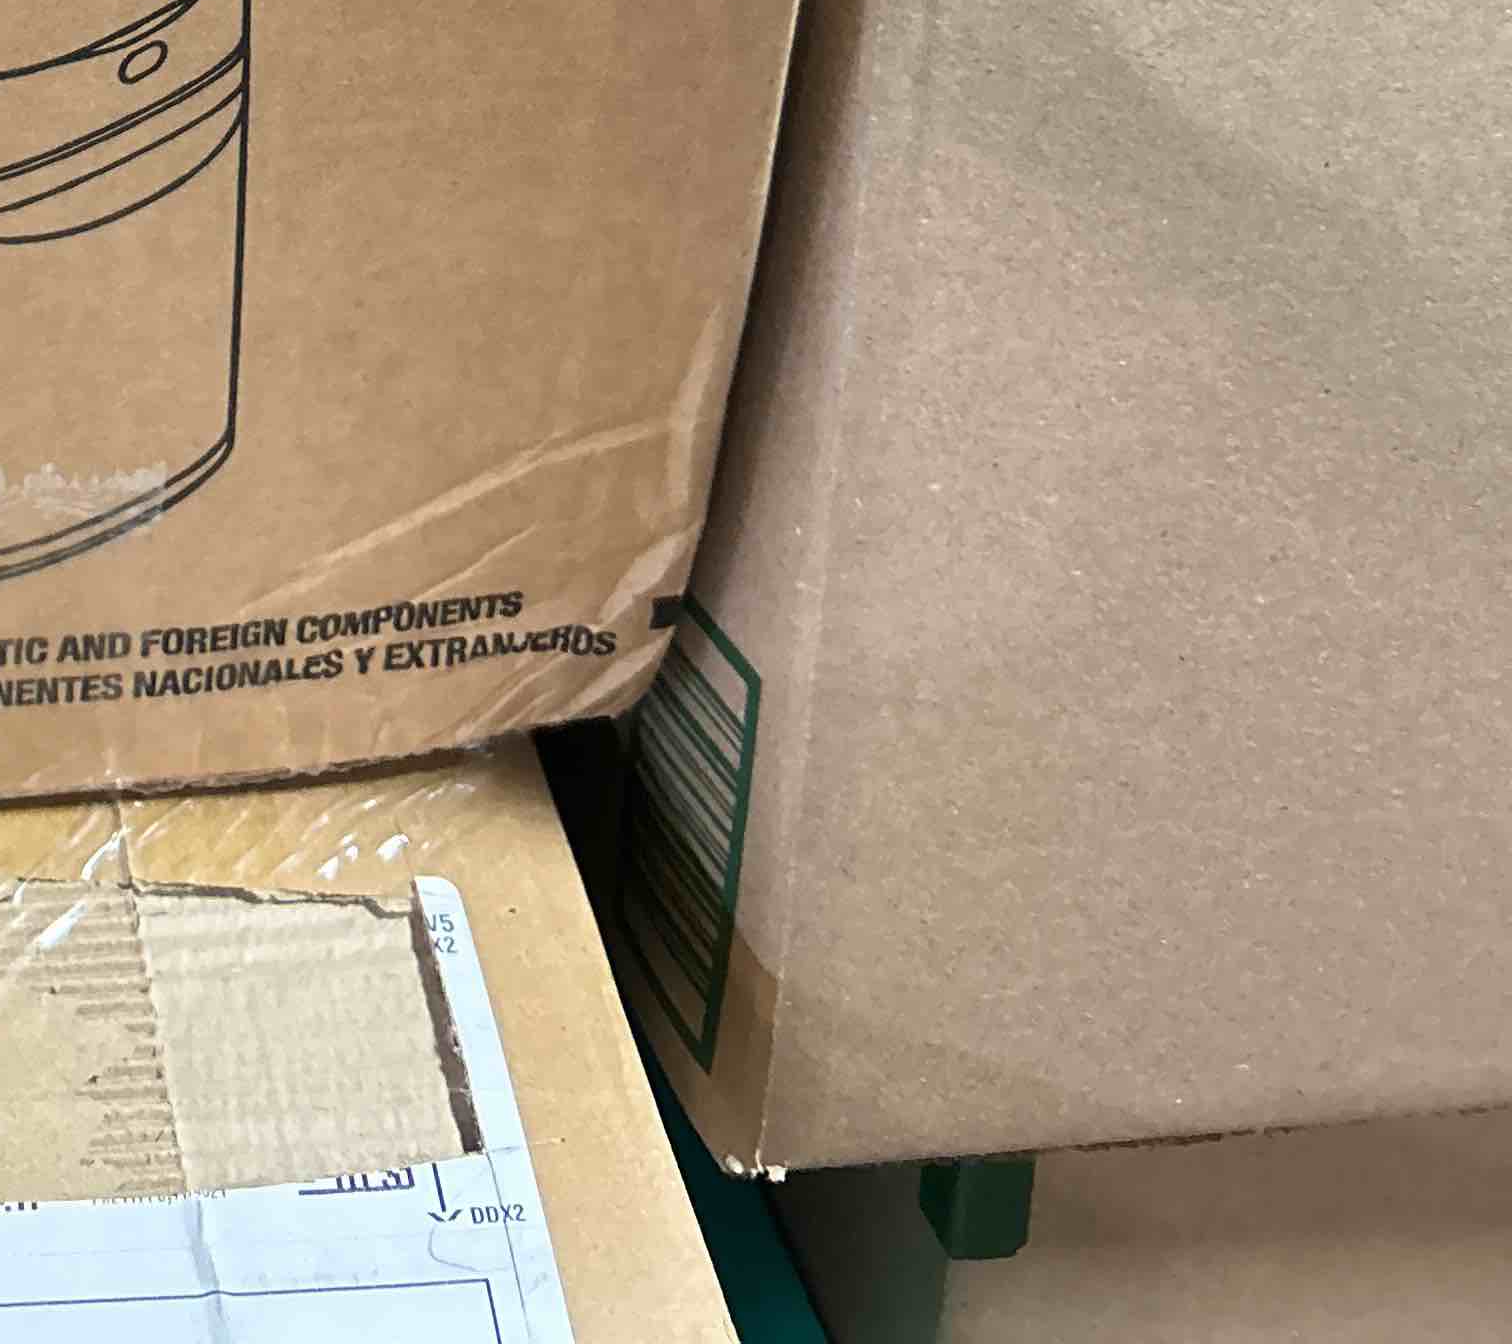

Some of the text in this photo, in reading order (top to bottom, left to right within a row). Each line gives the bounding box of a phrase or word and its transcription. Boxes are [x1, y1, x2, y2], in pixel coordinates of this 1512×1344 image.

[56, 630, 132, 663] AND
[139, 617, 288, 658] FOREIGN
[295, 590, 525, 644] COMPONENTS
[132, 649, 344, 700] NACIONALES
[353, 645, 376, 675] Y
[382, 623, 618, 672] EXTRANJEROS
[470, 1205, 527, 1225] DDX2
